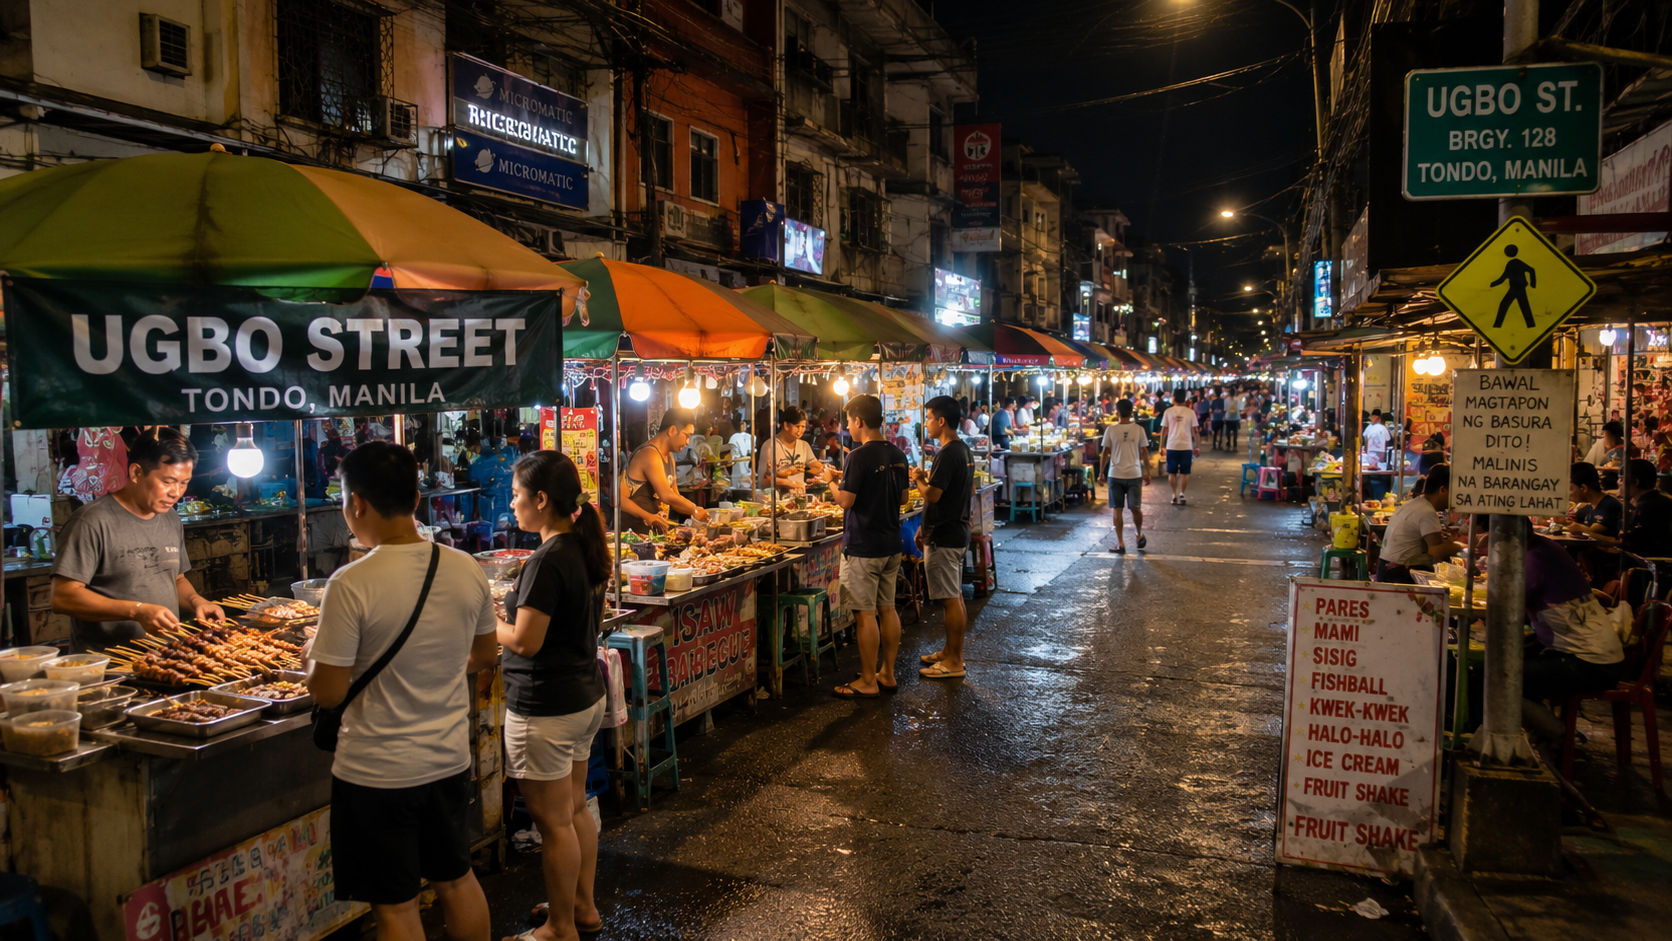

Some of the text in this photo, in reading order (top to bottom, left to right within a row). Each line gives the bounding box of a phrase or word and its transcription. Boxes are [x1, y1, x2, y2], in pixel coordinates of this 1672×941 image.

[499, 87, 573, 124] MICROMATIC
[1427, 80, 1582, 118] UGBO ST.
[1449, 127, 1557, 151] BRGY. 128
[499, 158, 573, 190] MICROMATIC
[1417, 157, 1588, 184] TONDO, MANILA
[71, 313, 527, 375] UGBO STREET
[1480, 374, 1540, 391] BAWAL
[180, 381, 447, 414] TONDO, MANILA
[1465, 396, 1549, 410] MAGTAPON
[1463, 415, 1552, 430] NG BASURA
[1485, 434, 1530, 449] DITO!
[1472, 456, 1538, 472] MALINIS
[1458, 476, 1560, 492] NA BARANGAY
[1456, 493, 1563, 510] SA ATING LAHAT
[1315, 597, 1370, 619] PARES
[1313, 622, 1360, 642] MAMI
[1312, 646, 1358, 667] SISIG
[1311, 671, 1388, 696] FISHBALL
[1309, 697, 1410, 724] KWEK-KWEK
[1307, 724, 1405, 750] HALO-HALO
[1306, 748, 1400, 777] ICE CREAM
[1303, 776, 1410, 807] FRUIT SHAKE
[1294, 815, 1420, 852] FRUIT SHAKE
